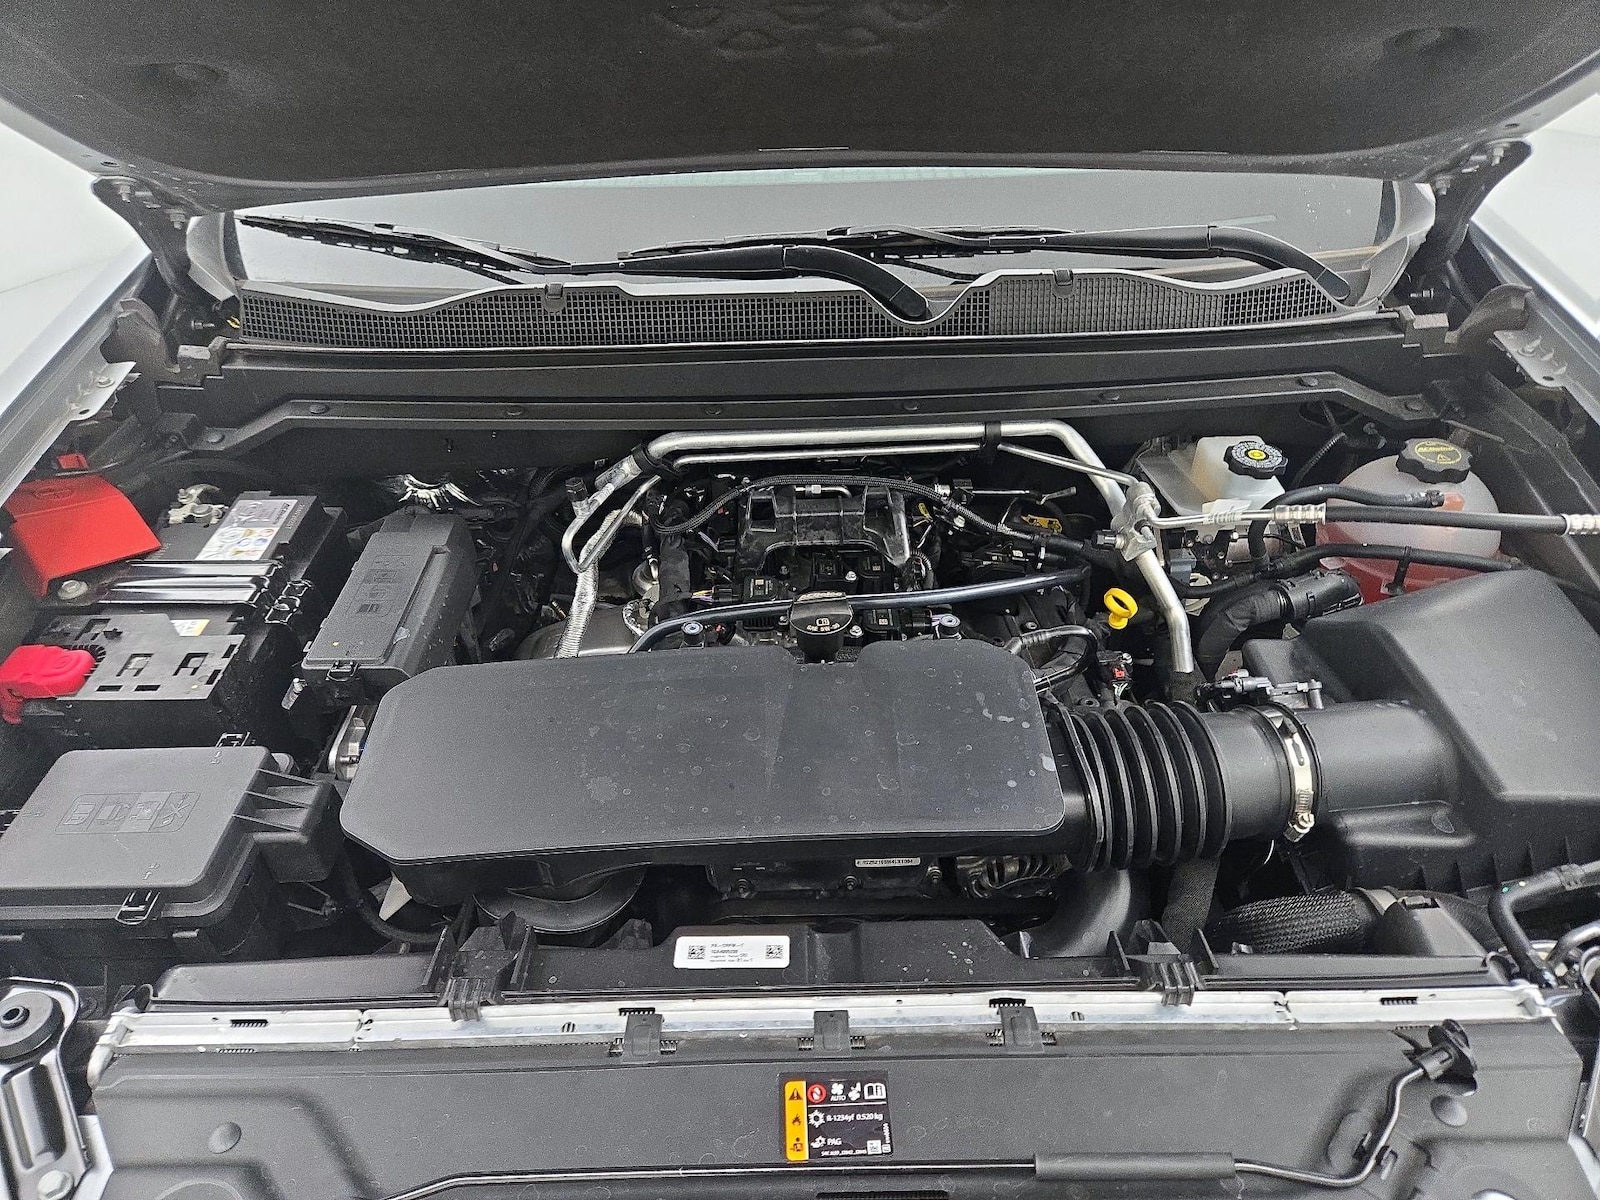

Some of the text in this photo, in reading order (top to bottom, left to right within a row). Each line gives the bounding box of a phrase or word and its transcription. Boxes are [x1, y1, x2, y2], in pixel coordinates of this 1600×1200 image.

[826, 1114, 854, 1122] R-1234yf
[874, 1113, 883, 1121] kg
[827, 1138, 842, 1146] PAG
